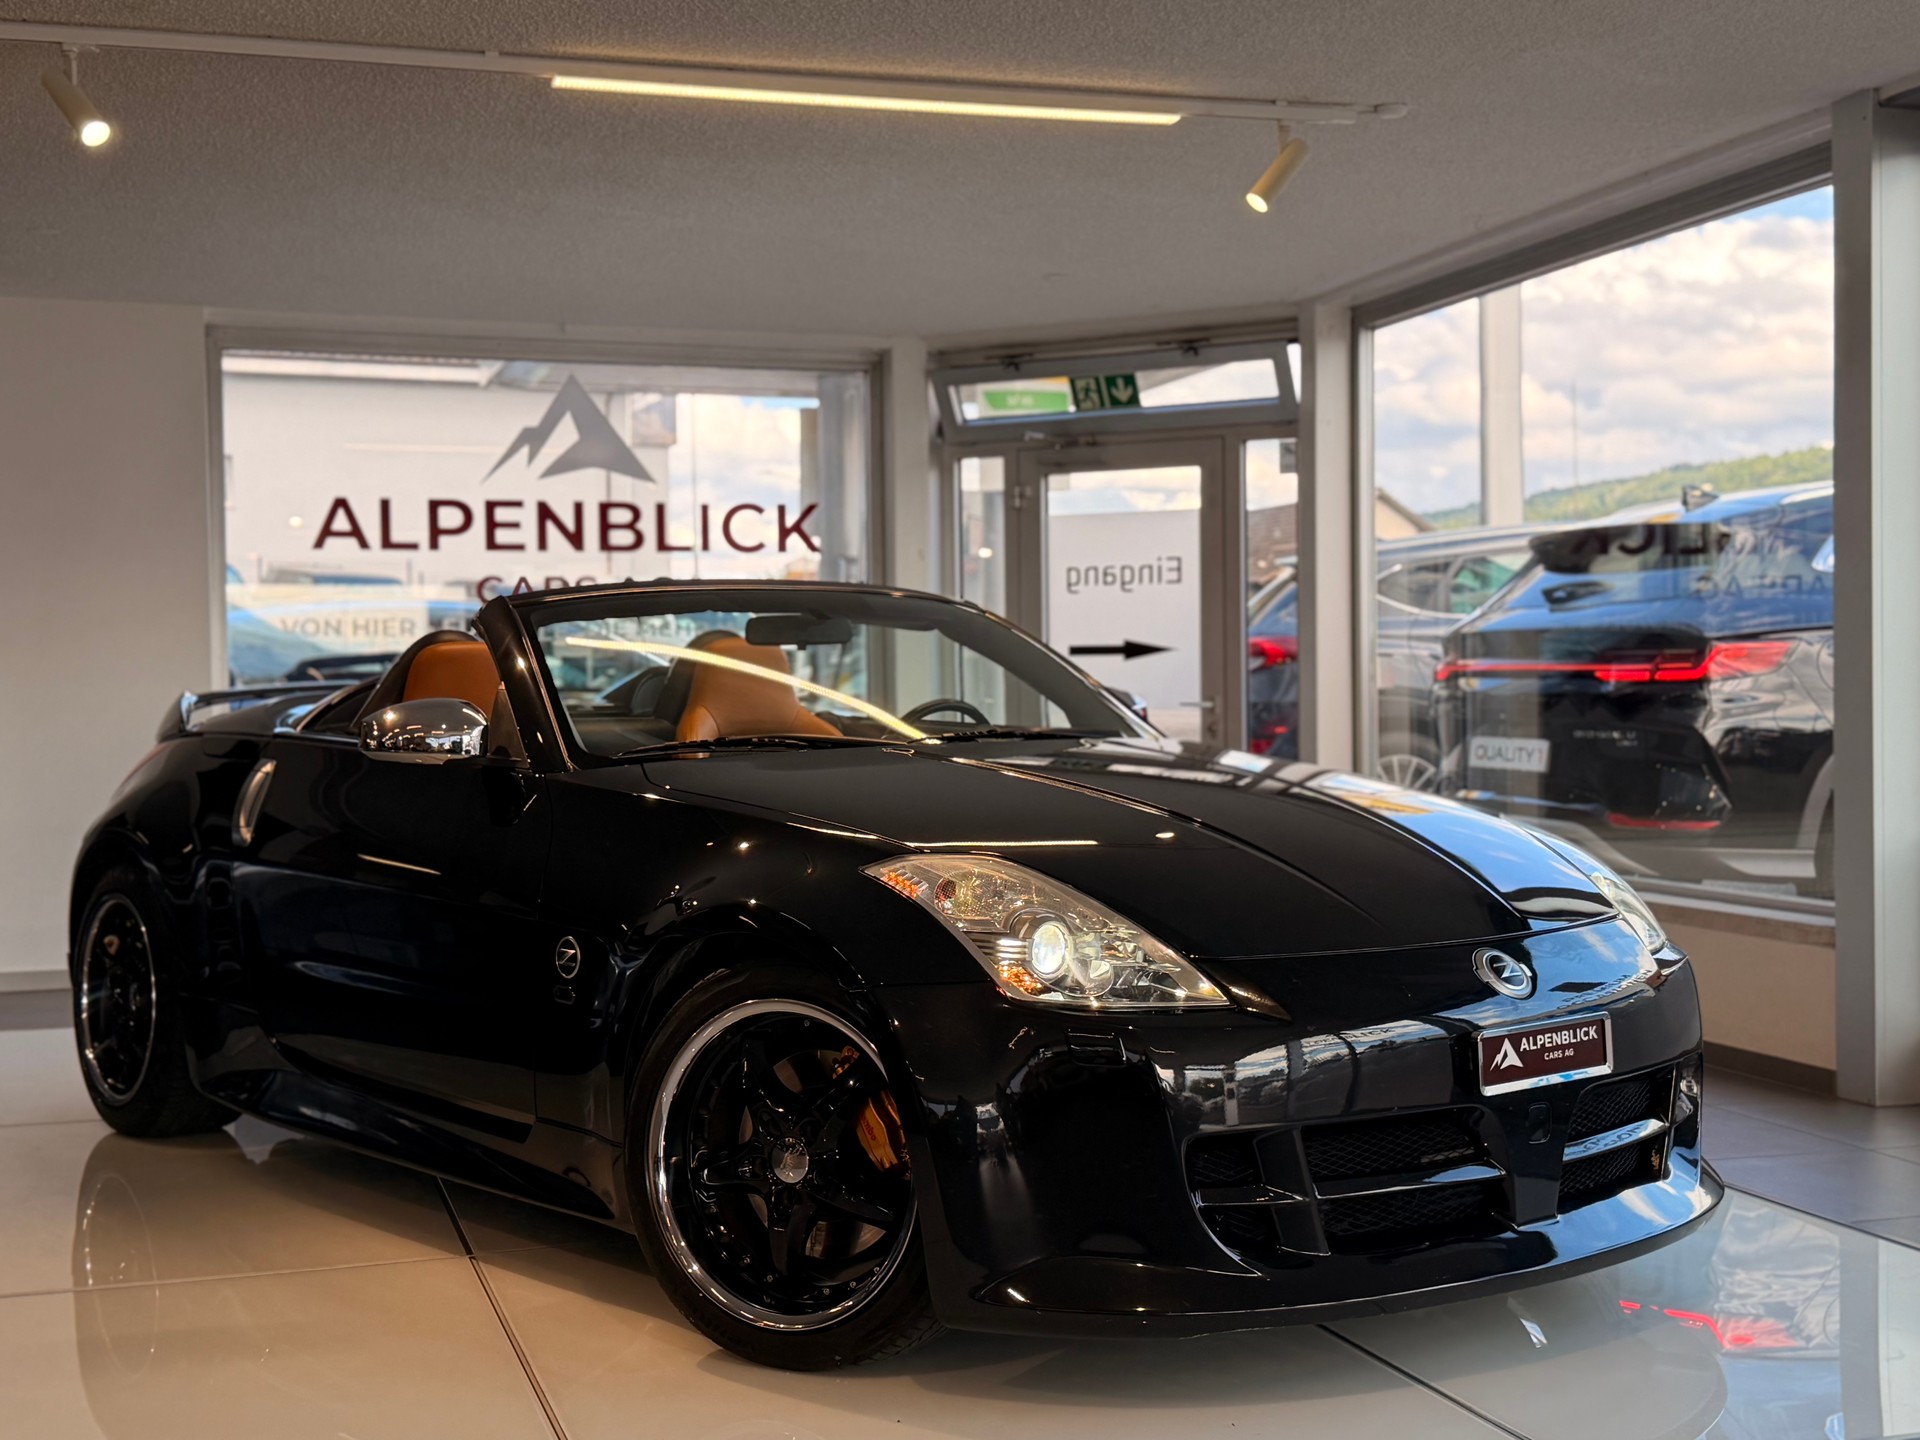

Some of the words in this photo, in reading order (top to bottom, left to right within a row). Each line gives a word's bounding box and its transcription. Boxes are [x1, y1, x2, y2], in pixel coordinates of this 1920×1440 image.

[313, 497, 822, 553] ALPENBLICK
[1519, 1025, 1599, 1052] ALPENBLICK
[1543, 1049, 1563, 1061] CARS
[1564, 1048, 1574, 1057] AG
